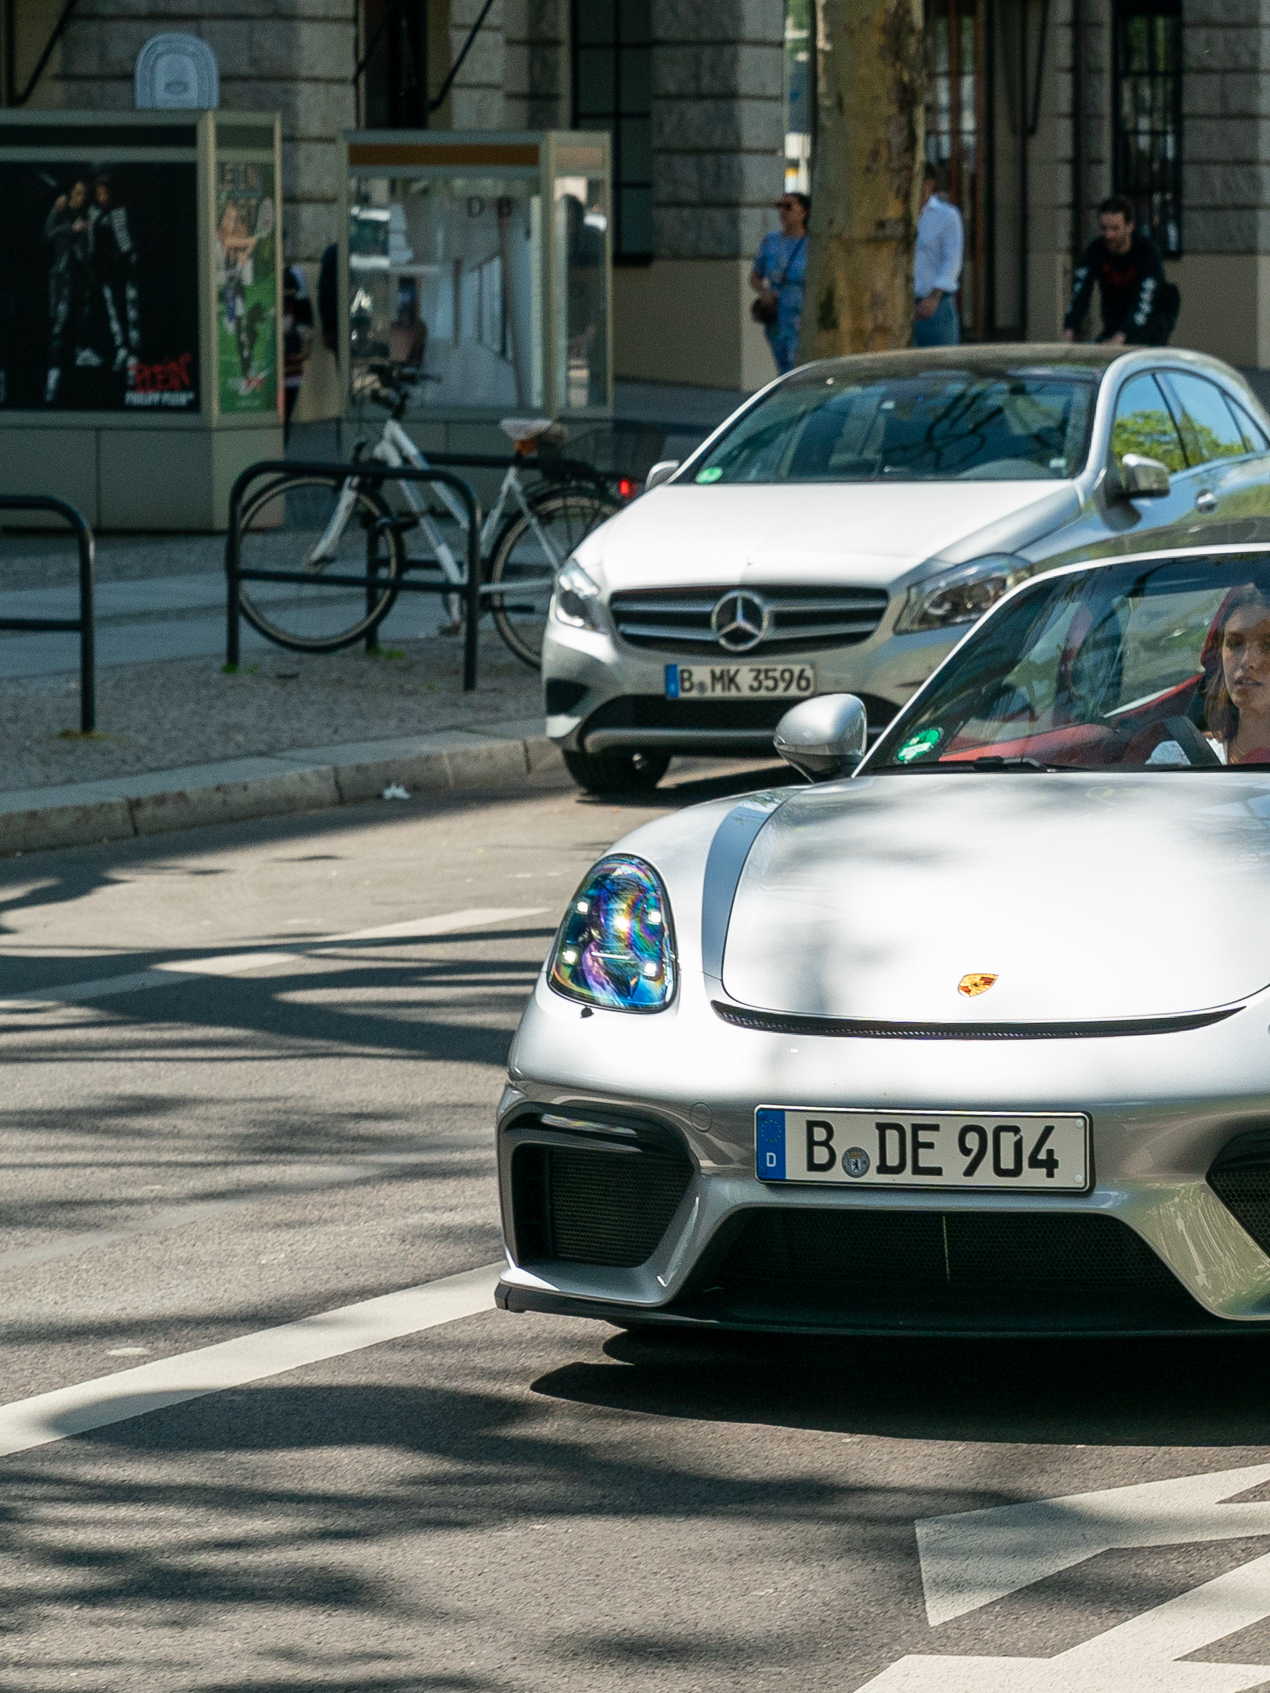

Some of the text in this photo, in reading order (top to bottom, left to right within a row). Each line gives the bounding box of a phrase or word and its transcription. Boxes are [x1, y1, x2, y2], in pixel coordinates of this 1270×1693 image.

[680, 668, 812, 693] B MK 3596
[766, 1152, 777, 1168] D
[806, 1119, 1060, 1179] B DE 904
